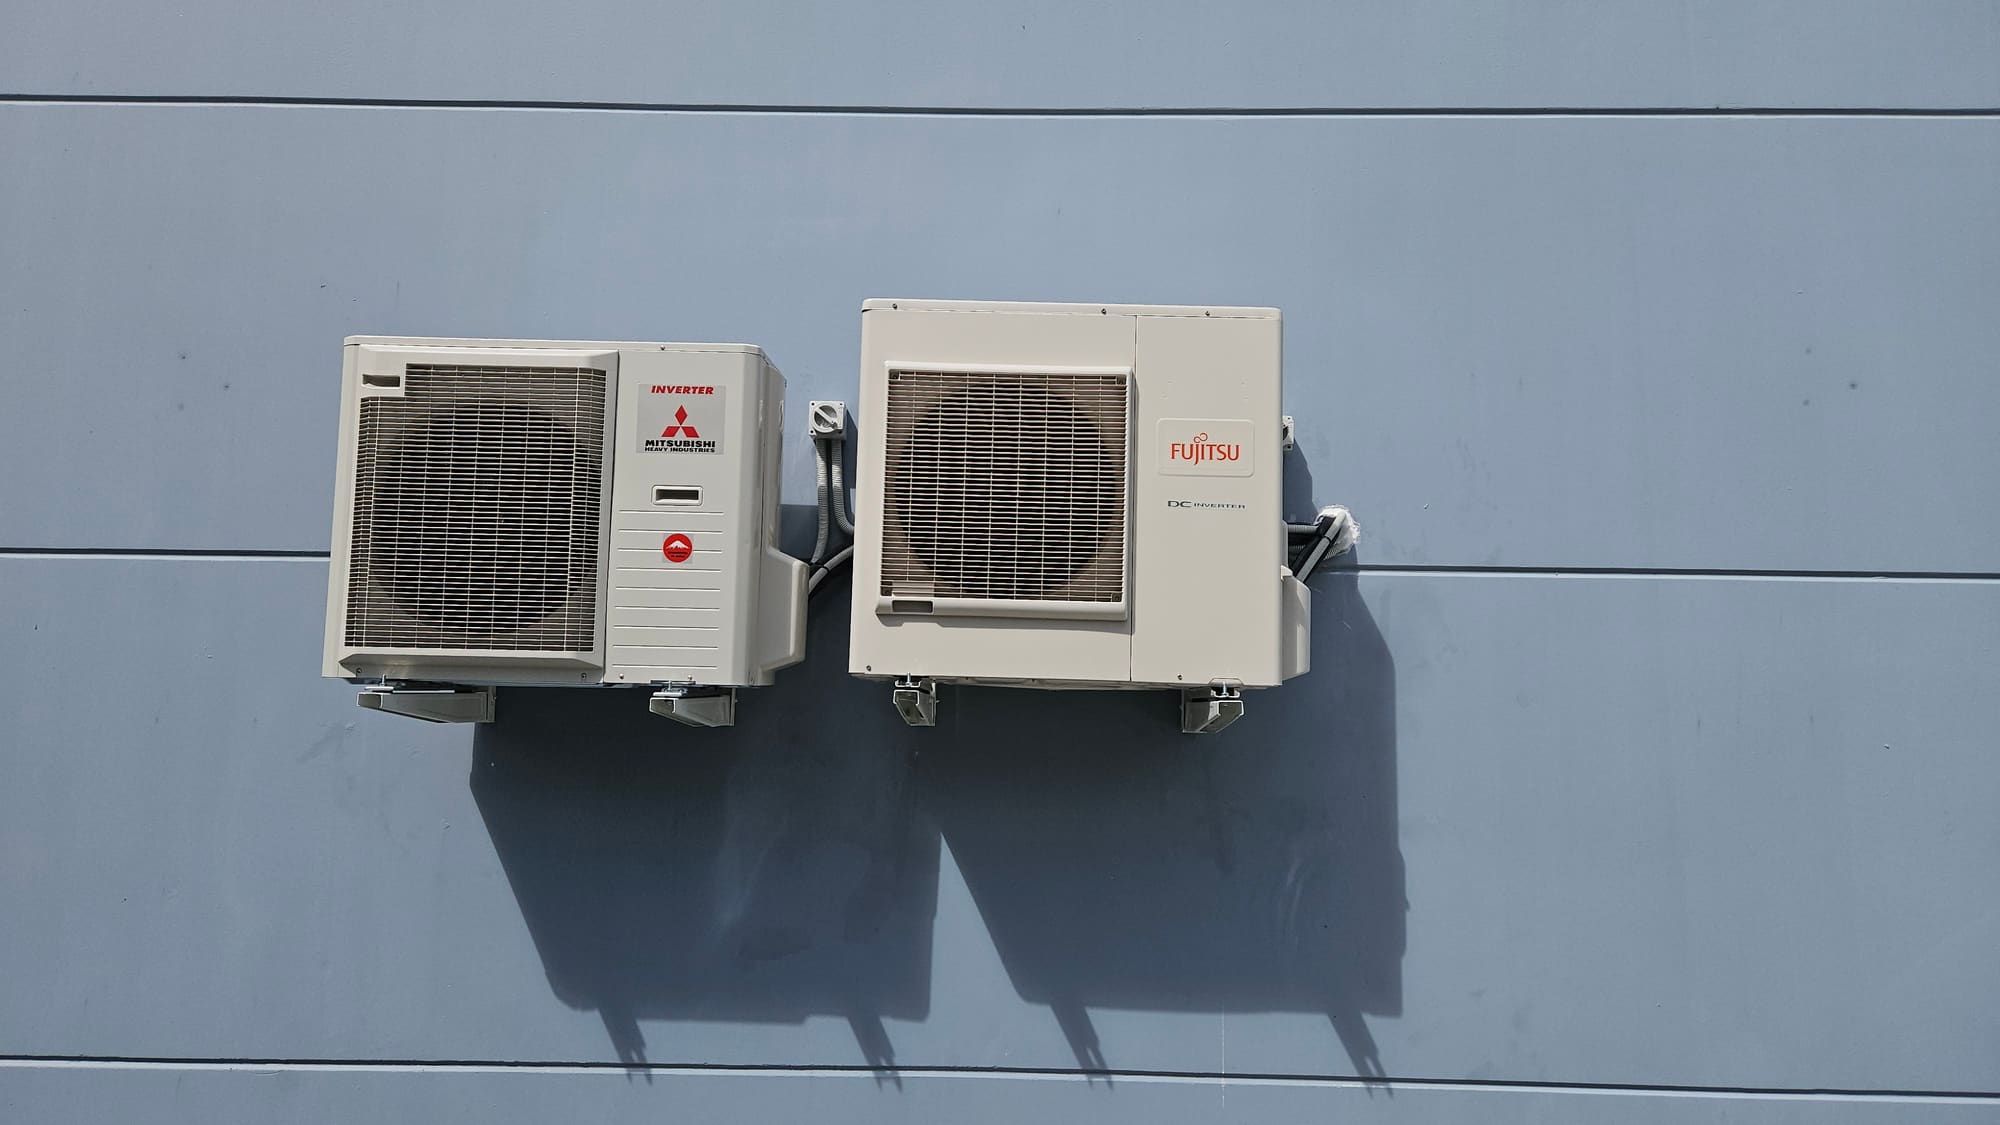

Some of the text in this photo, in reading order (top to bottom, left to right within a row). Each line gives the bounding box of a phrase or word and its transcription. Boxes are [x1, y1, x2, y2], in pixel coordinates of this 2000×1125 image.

[651, 385, 714, 395] INVERTER
[645, 440, 715, 448] MITSUBISHI
[1171, 432, 1240, 465] FUJITSU
[1167, 500, 1192, 508] DC
